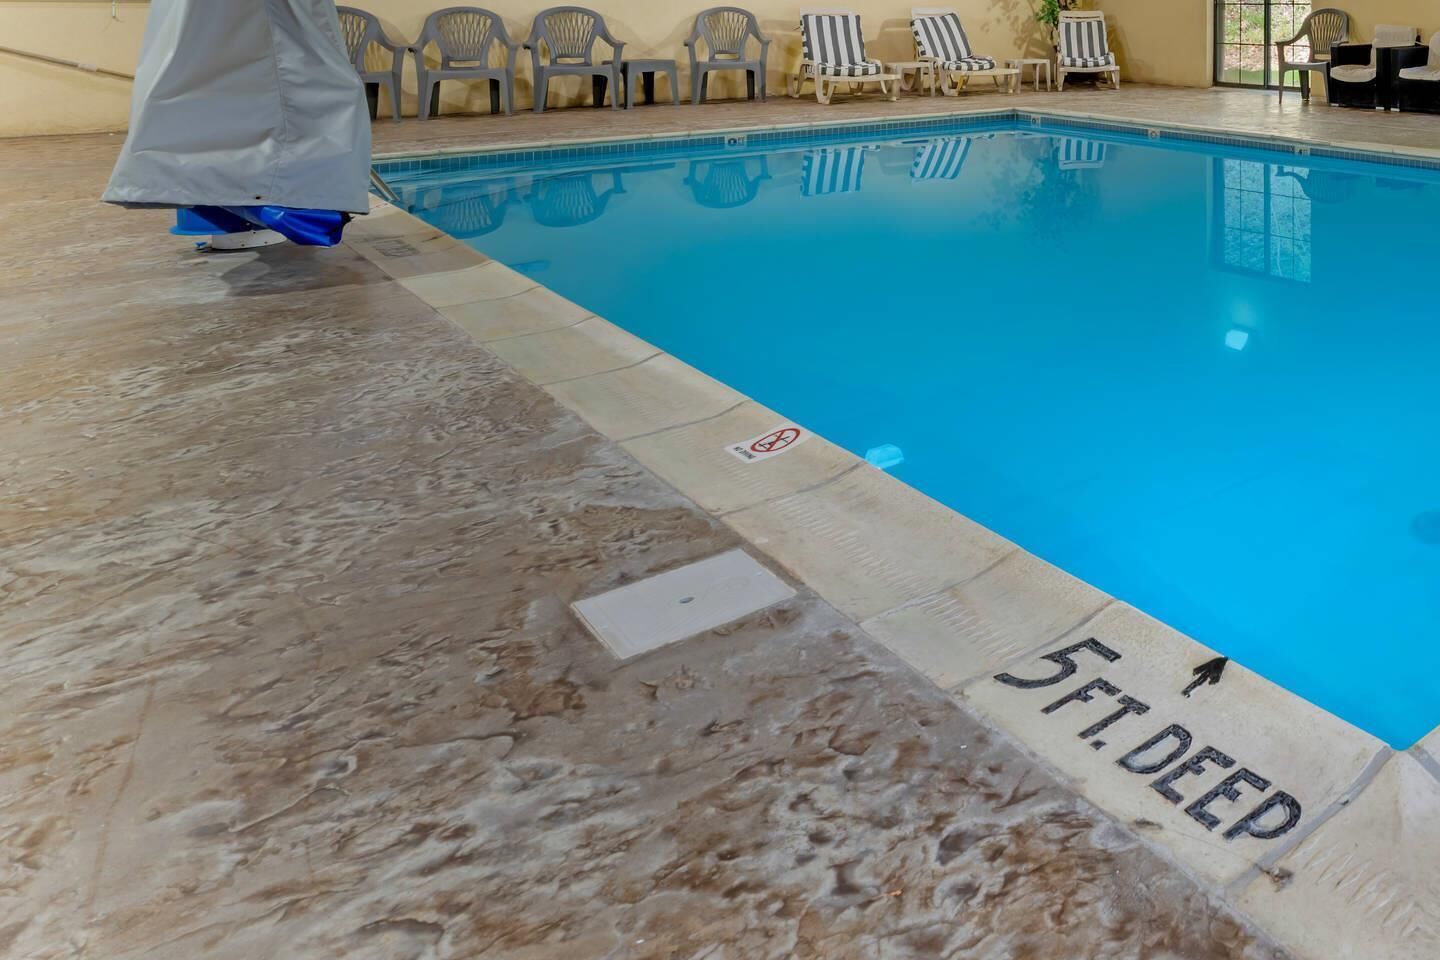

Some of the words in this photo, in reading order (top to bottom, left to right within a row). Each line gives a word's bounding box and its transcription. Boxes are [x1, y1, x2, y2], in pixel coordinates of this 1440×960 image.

[993, 637, 1122, 689] 5
[1040, 677, 1150, 751] FT.
[1116, 723, 1302, 841] DEEP
